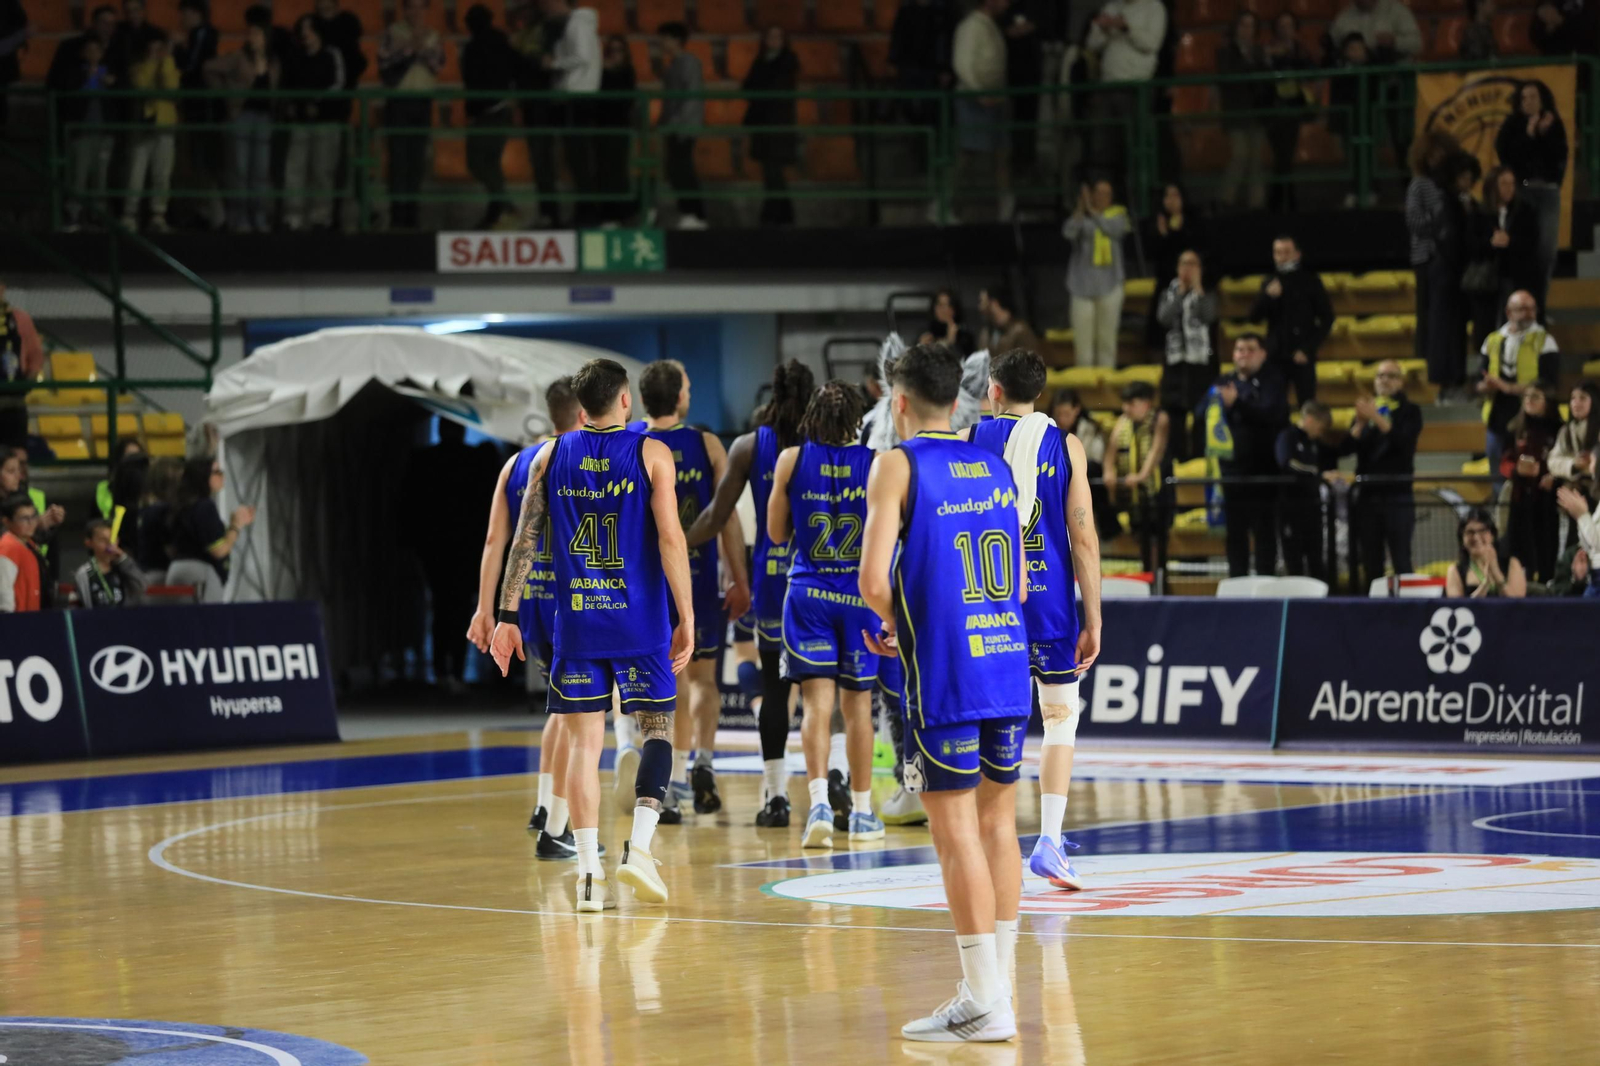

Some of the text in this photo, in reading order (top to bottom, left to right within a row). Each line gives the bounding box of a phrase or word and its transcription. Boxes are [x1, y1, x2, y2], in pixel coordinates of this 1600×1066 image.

[450, 236, 564, 266] SAIDA
[557, 485, 605, 501] cloud.gal
[936, 496, 994, 517] cloud.gal
[569, 513, 625, 570] 41
[808, 512, 862, 561] 22
[954, 529, 1014, 604] 10
[584, 602, 628, 610] DE GALICIA
[983, 634, 1012, 644] XUNTA
[984, 645, 997, 655] DE
[160, 643, 319, 686] HYUNDAI
[210, 695, 283, 718] Hyupersa
